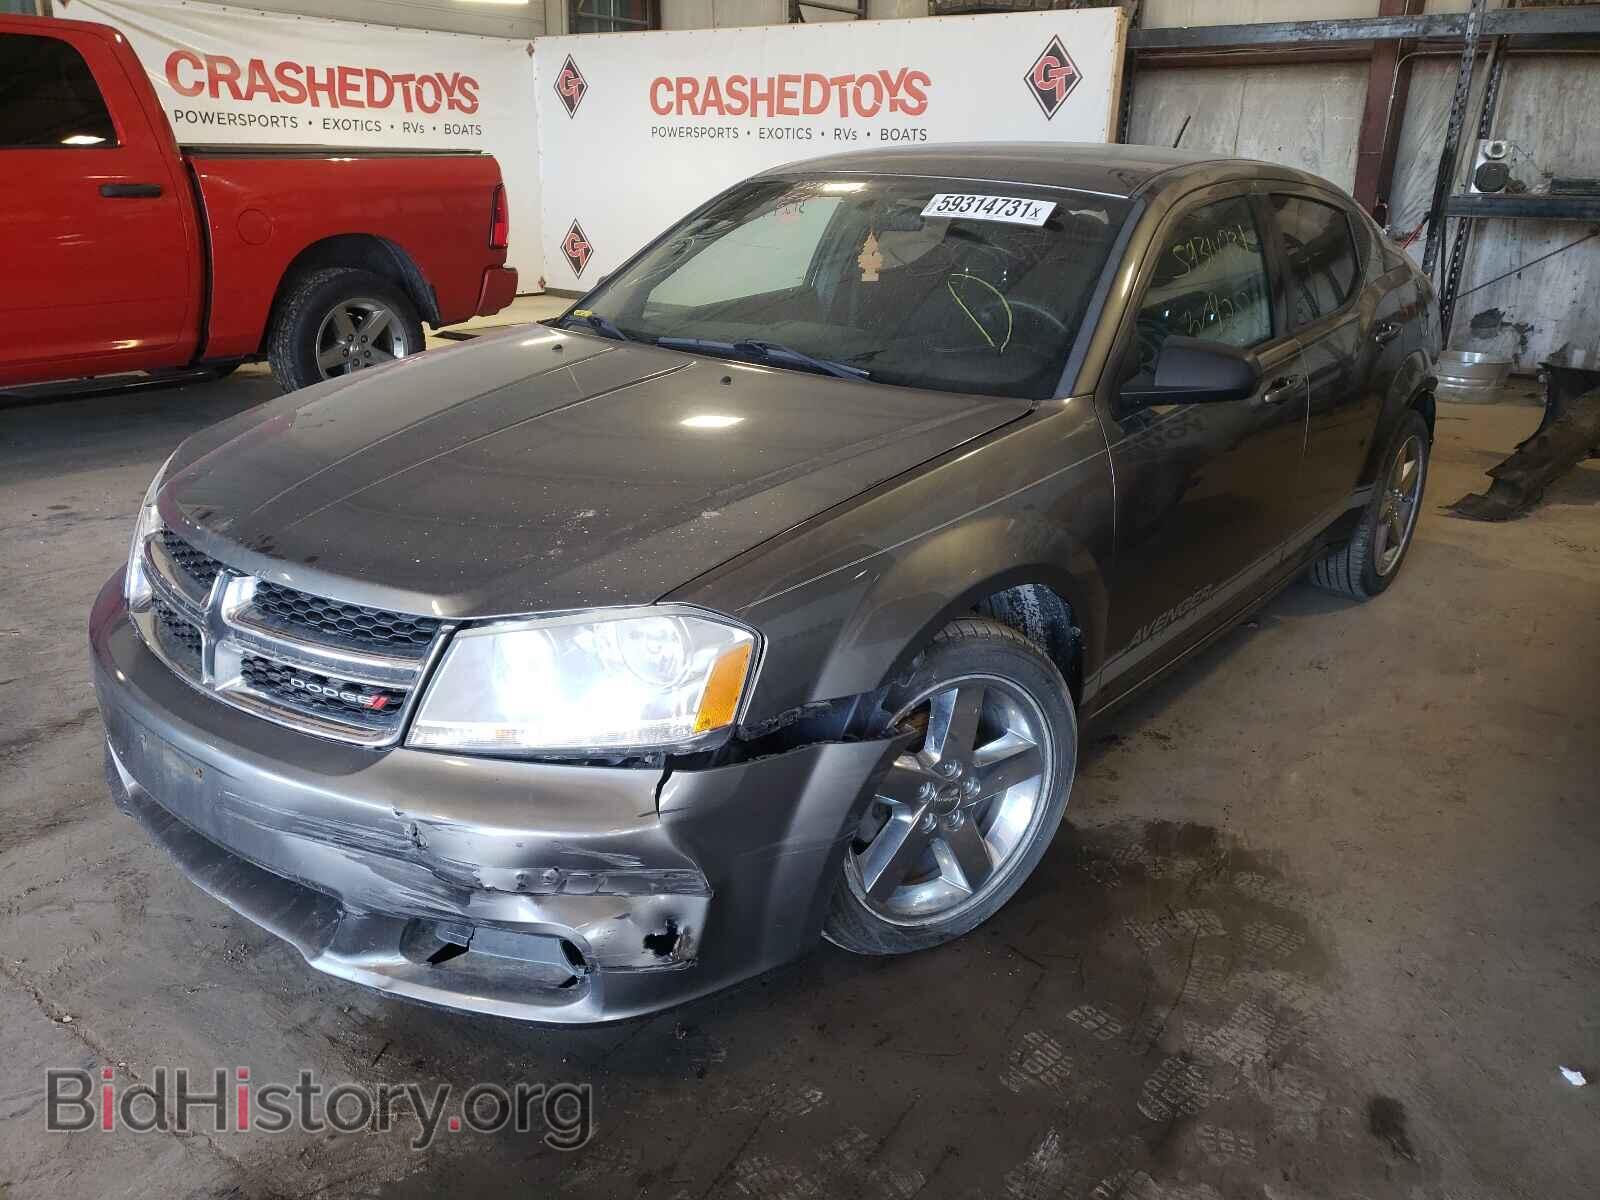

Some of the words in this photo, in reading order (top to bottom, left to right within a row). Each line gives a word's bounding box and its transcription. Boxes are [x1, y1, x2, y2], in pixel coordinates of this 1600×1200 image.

[164, 50, 480, 115] CRASHEDTOYS
[650, 67, 932, 119] CRASHEDTOYS
[174, 109, 298, 130] POWERSPORTS
[322, 119, 383, 133] EXOTICS
[402, 121, 425, 135] RVs
[443, 122, 482, 136] BOATS
[651, 126, 740, 140] POWERSPORTS
[758, 127, 813, 140] EXOTICS
[833, 127, 858, 141] RVs
[880, 128, 928, 142] BOATS
[1131, 584, 1216, 646] AVENGER
[290, 677, 373, 705] DODGE
